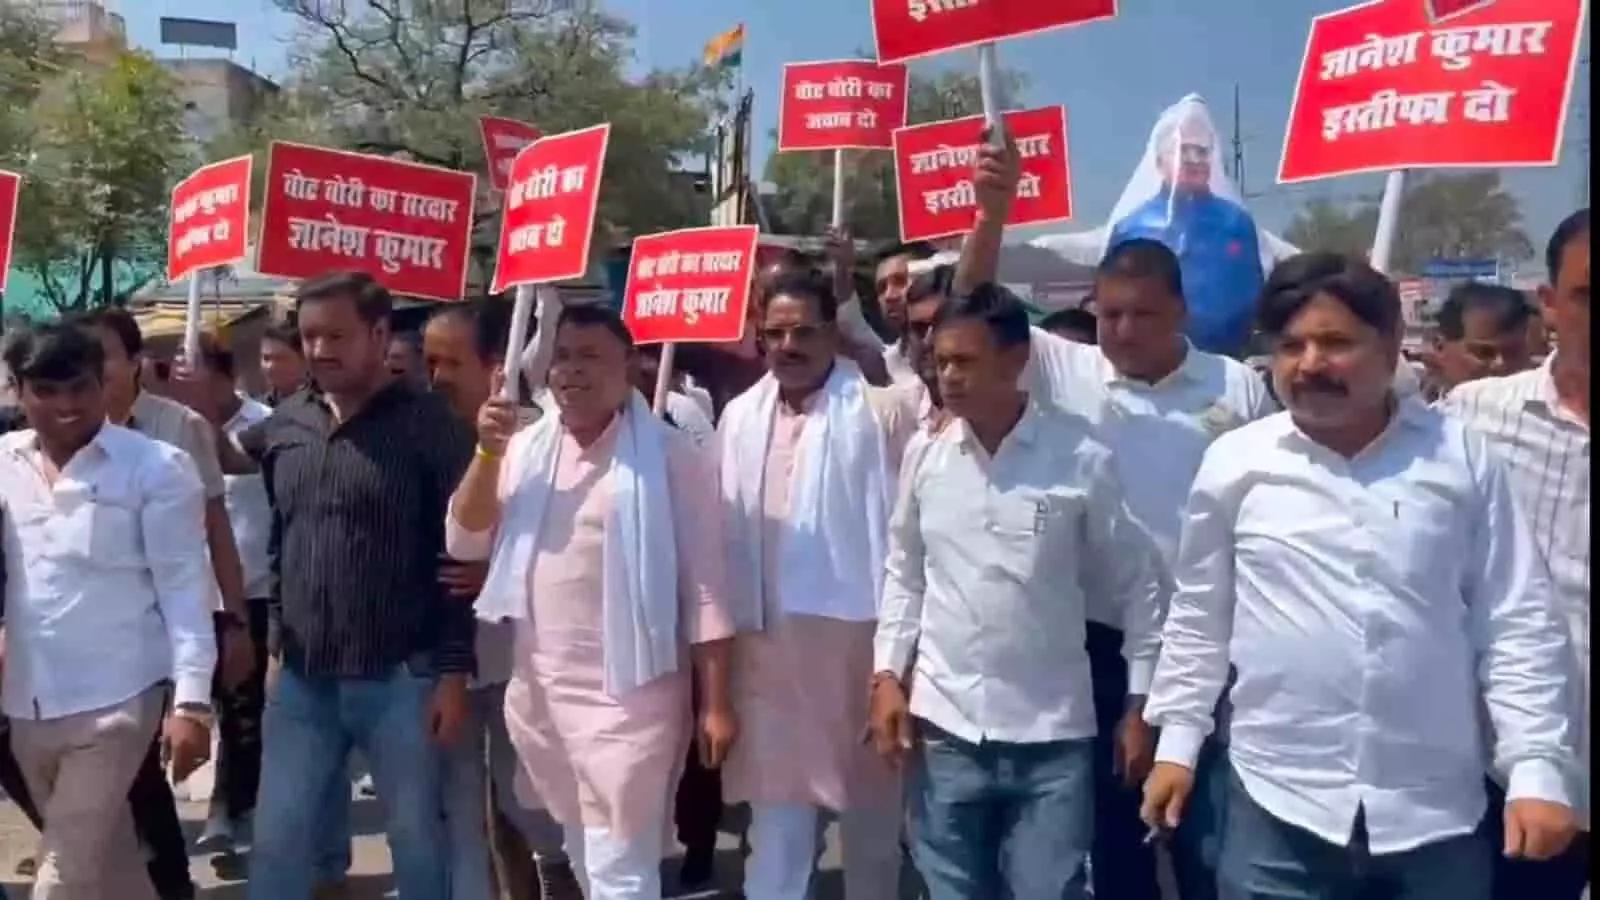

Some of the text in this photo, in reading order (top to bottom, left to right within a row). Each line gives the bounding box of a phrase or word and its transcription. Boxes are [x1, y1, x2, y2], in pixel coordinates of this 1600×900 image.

[1319, 21, 1553, 81] ज्ञानेश कुमार
[1322, 80, 1516, 142] इस्तीफा दो
[368, 186, 398, 213] का
[287, 213, 448, 274] ज्ञानेश कुमार
